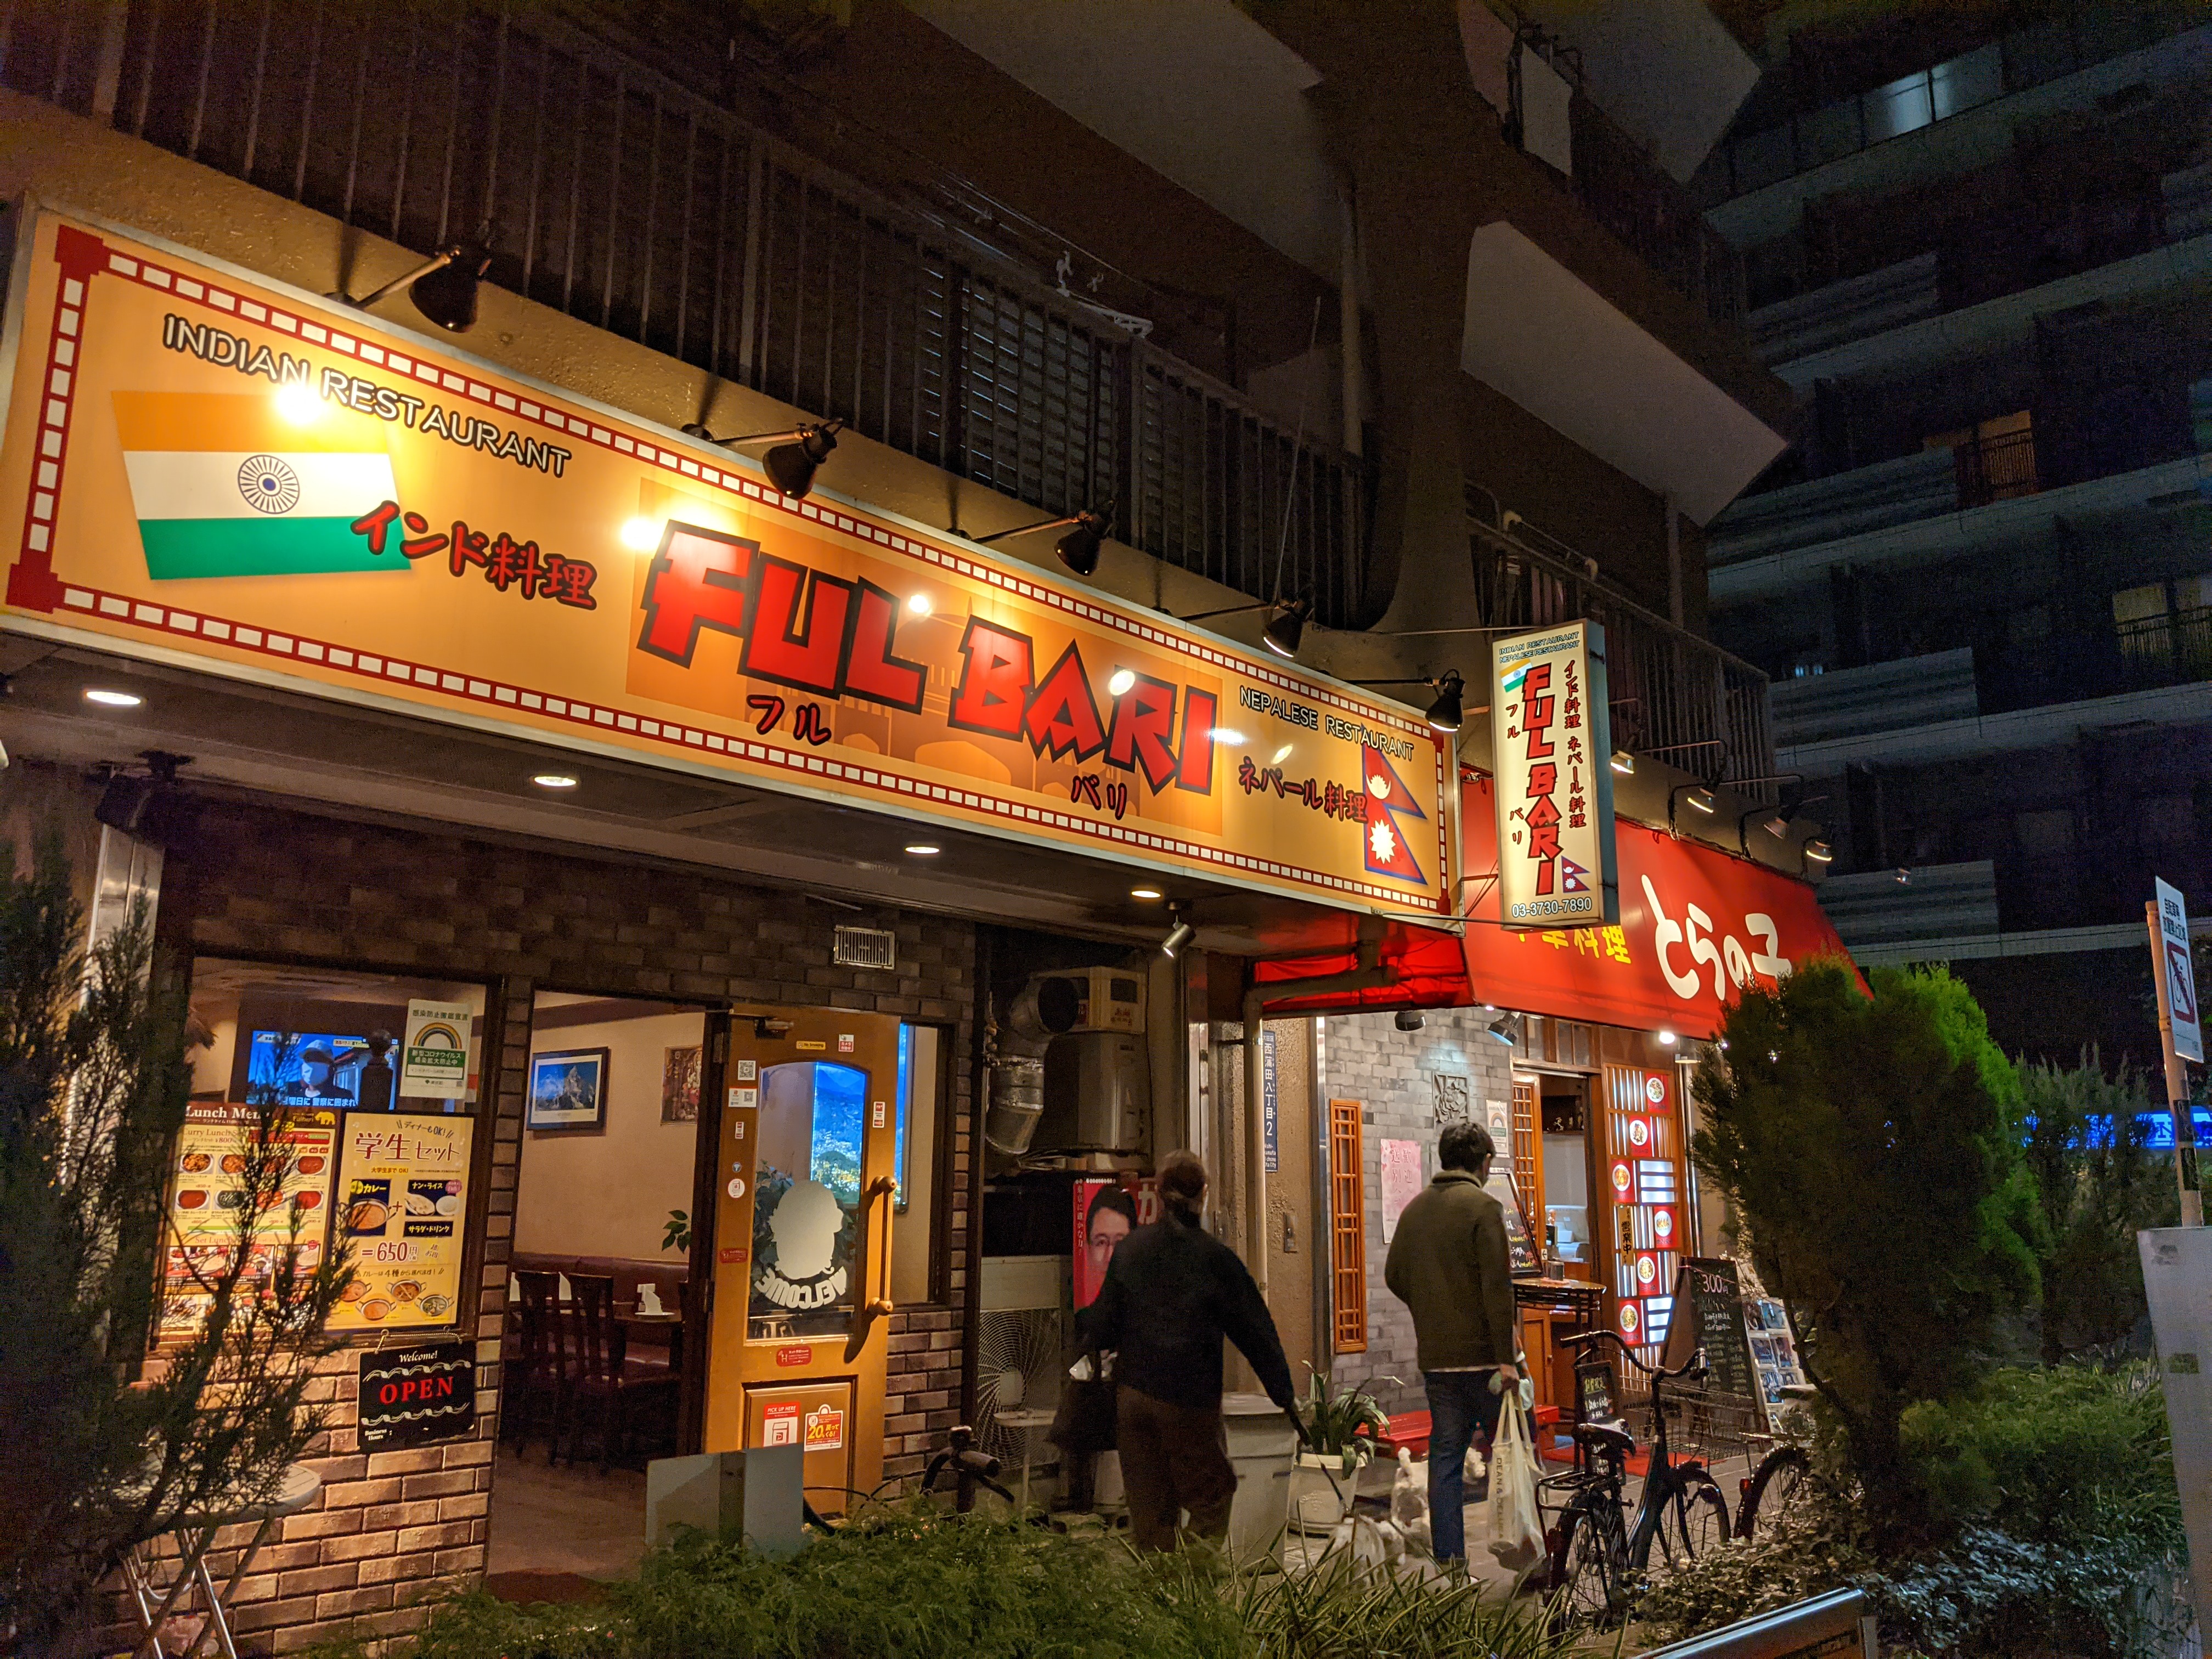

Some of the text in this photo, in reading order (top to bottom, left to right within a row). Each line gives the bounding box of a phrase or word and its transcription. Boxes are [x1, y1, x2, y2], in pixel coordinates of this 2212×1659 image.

[162, 313, 572, 478] INDIAN RESTAURANT
[349, 500, 598, 611] インド料理
[636, 519, 1218, 797] FUL BARI
[1499, 631, 1579, 654] INDIAN RESTAURANT
[1499, 640, 1579, 663] NEPALESE RESTAURANT
[746, 693, 831, 746] フル
[1239, 685, 1414, 761] NEPALESE RESTAURANT
[1505, 704, 1520, 739] フル
[1564, 659, 1587, 828] インド料理 ネパール料理
[1069, 773, 1128, 821] バリ
[1239, 756, 1368, 823] ネパール料理
[1521, 662, 1564, 896] FUL BARI
[1509, 807, 1524, 845] バリ
[1511, 897, 1592, 917] 03-3730-7890
[185, 1105, 227, 1118] Lunch
[363, 1184, 387, 1194] カレー
[195, 1235, 210, 1244] Set
[399, 1351, 438, 1363] Welcome!
[379, 1376, 454, 1405] OPEN
